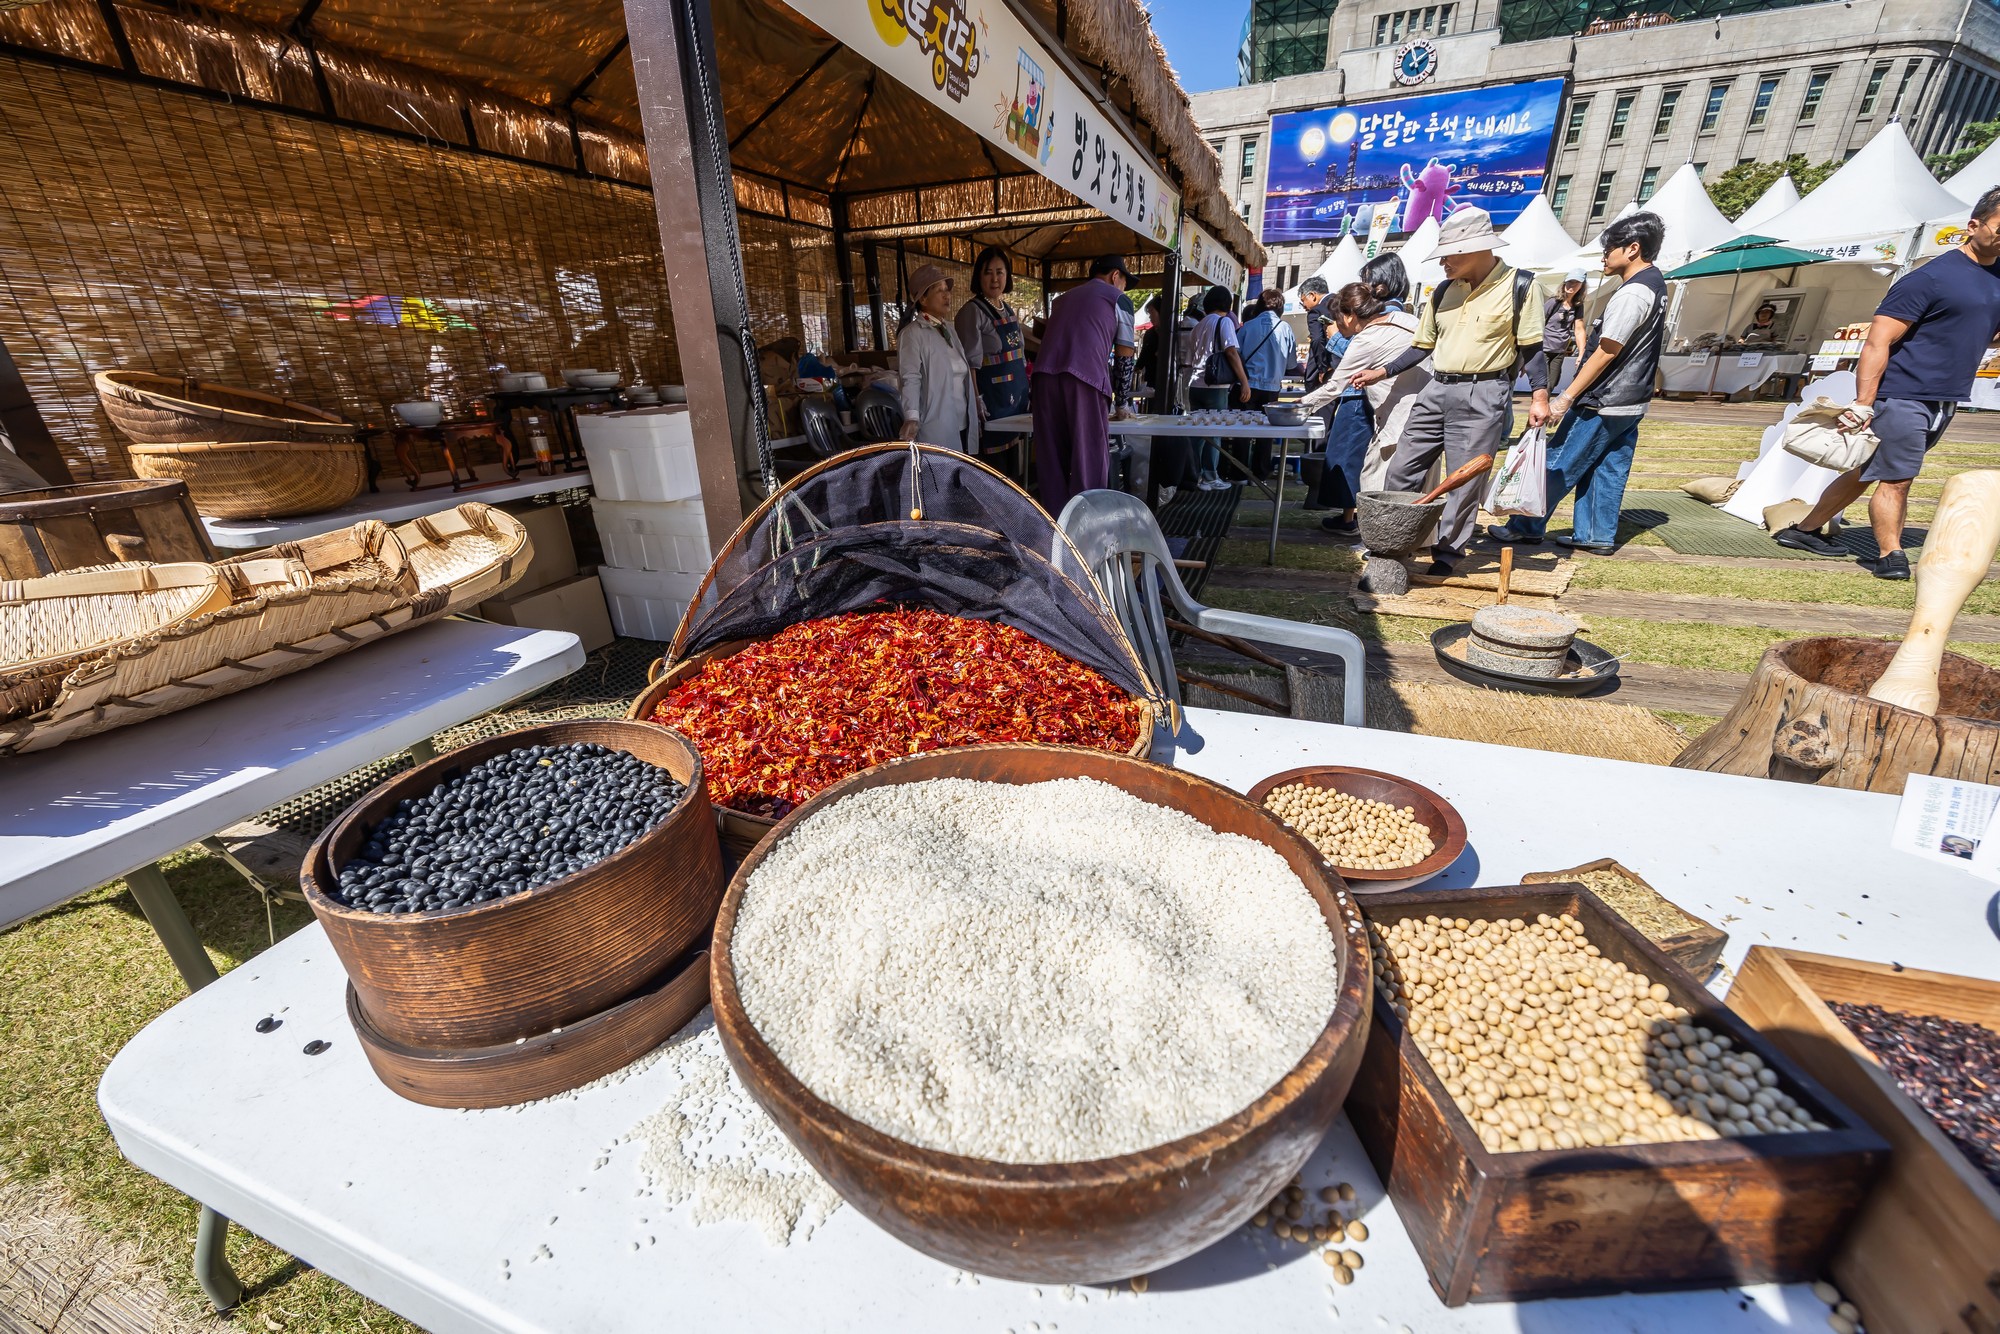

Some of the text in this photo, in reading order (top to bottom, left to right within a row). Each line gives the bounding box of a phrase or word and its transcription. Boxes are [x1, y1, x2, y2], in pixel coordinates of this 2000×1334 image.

[948, 82, 960, 98] Market
[1359, 110, 1532, 151] 달달한 추석 보내세요
[1072, 112, 1145, 222] 방앗간체험
